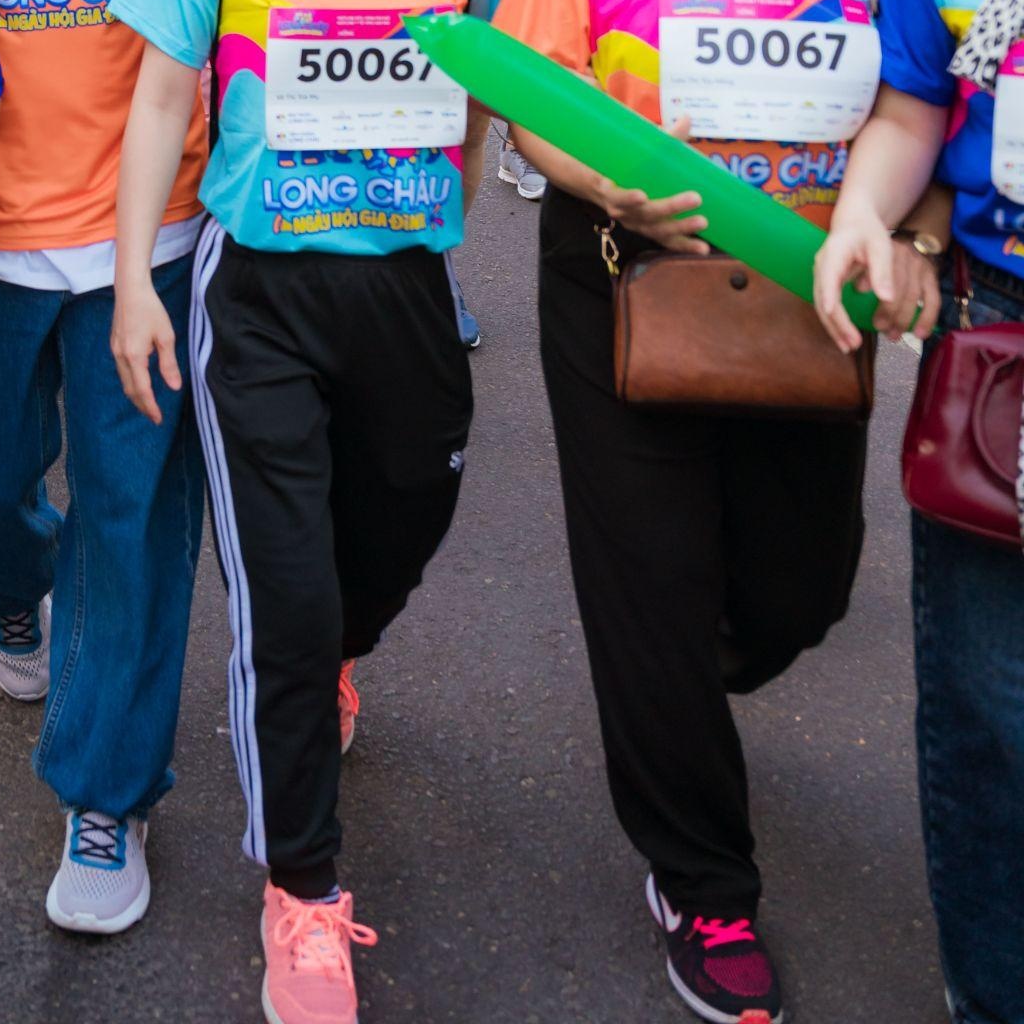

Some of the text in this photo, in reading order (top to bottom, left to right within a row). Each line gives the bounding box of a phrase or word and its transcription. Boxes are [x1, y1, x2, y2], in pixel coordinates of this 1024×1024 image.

[77, 6, 103, 26] GIA
[695, 26, 847, 72] 50067
[263, 168, 452, 211] LONG CHÂU
